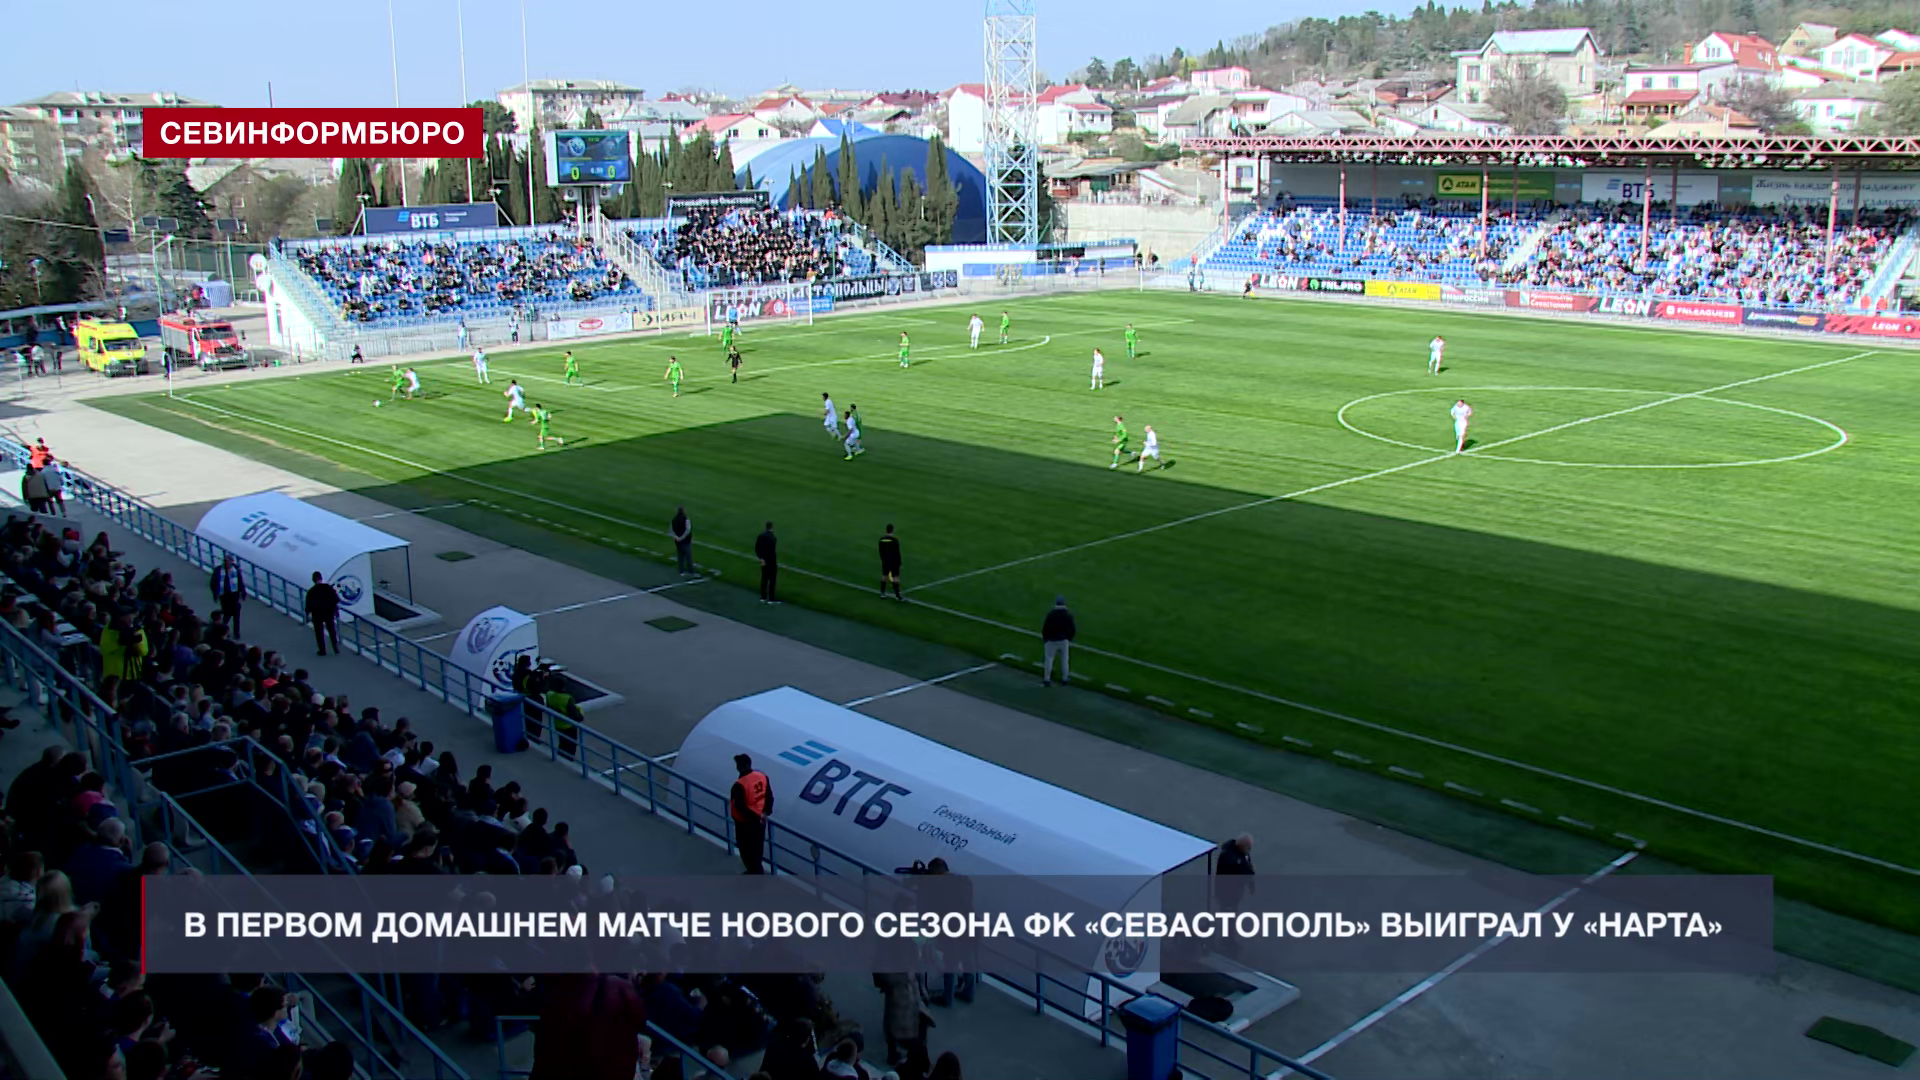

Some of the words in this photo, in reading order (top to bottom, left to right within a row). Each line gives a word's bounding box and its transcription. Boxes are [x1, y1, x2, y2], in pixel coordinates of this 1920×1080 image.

[571, 167, 580, 180] 0
[410, 212, 439, 228] ВТБ
[715, 300, 761, 320] LON
[1599, 297, 1652, 315] LEON
[1871, 321, 1900, 331] LEON
[241, 518, 289, 549] ВТБ
[798, 758, 913, 830] ВТБ
[933, 804, 1017, 846] Генеральный
[917, 821, 969, 851] спонсор
